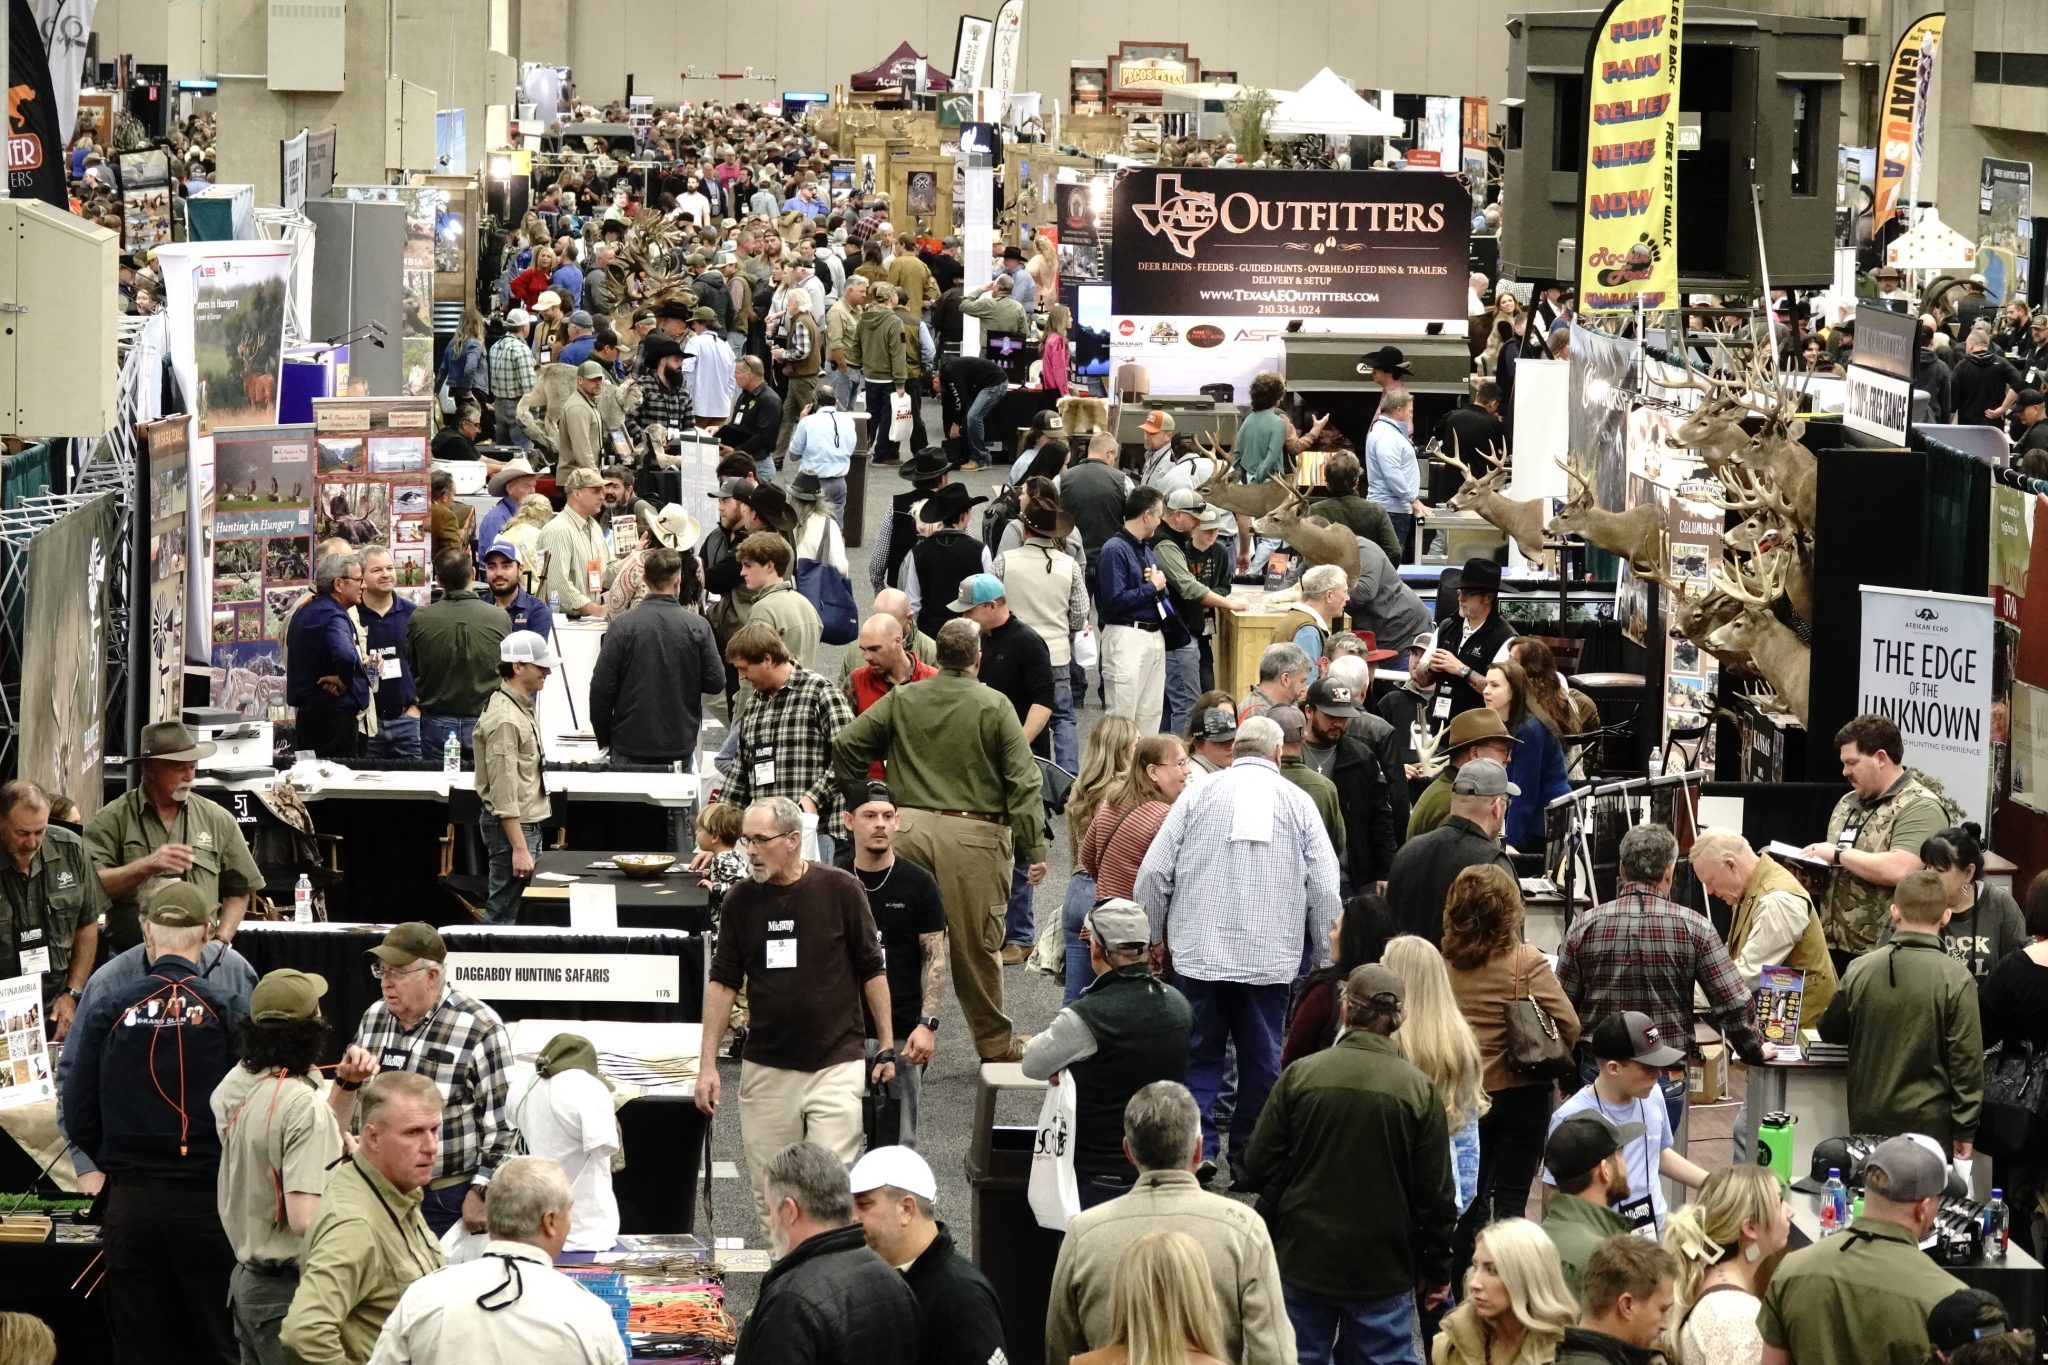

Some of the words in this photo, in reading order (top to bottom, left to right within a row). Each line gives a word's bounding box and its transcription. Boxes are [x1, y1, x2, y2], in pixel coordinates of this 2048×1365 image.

[1610, 14, 1667, 44] FOOT
[963, 43, 973, 69] TRULY
[969, 44, 980, 72] GREEK
[1602, 53, 1662, 84] PAIN
[1669, 44, 1677, 86] BACK
[1121, 68, 1153, 86] PECOS
[1594, 93, 1671, 126] RELIEF
[1592, 138, 1656, 169] HERE
[1665, 121, 1674, 161] FREE
[1664, 166, 1673, 202] TEST
[1590, 187, 1655, 220] NOW
[1663, 205, 1672, 248] WALK
[1138, 262, 1161, 271] DEER
[1162, 262, 1192, 272] BLINDS
[1197, 263, 1234, 272] FEEDERS
[1239, 264, 1273, 273] GUIDED
[1274, 264, 1303, 274] HUNTS
[1308, 264, 1354, 274] OVERHEAD
[1355, 265, 1377, 275] FEED
[1378, 266, 1397, 275] BINS
[1407, 266, 1448, 275] TRAILERS
[1252, 275, 1293, 285] DELIVERY
[1304, 276, 1332, 285] SETUP
[1258, 304, 1321, 315] 210.334.1024
[1868, 386, 1883, 425] FREE
[1883, 390, 1906, 432] RANGE
[216, 521, 249, 534] Hunting
[250, 521, 259, 531] in
[261, 518, 295, 534] Hungary
[1680, 520, 1714, 535] COLUMBIA
[1905, 622, 1931, 631] AFRICAN
[1932, 625, 1949, 633] ECHO
[1873, 638, 1915, 676] THE
[1922, 644, 1977, 684] EDGE
[1909, 681, 1920, 696] OF
[1921, 683, 1939, 699] THE
[1753, 729, 1771, 758] KANSAS
[1910, 739, 1940, 751] HUNTING
[1941, 744, 1981, 755] EXPERIENCE
[1945, 935, 1990, 954] OCK
[455, 966, 512, 982] DAGGABOY
[515, 967, 562, 983] HUNTING
[565, 968, 610, 983] SAFARIS
[656, 990, 670, 998] 1175
[1821, 1195, 1835, 1206] FIJI
